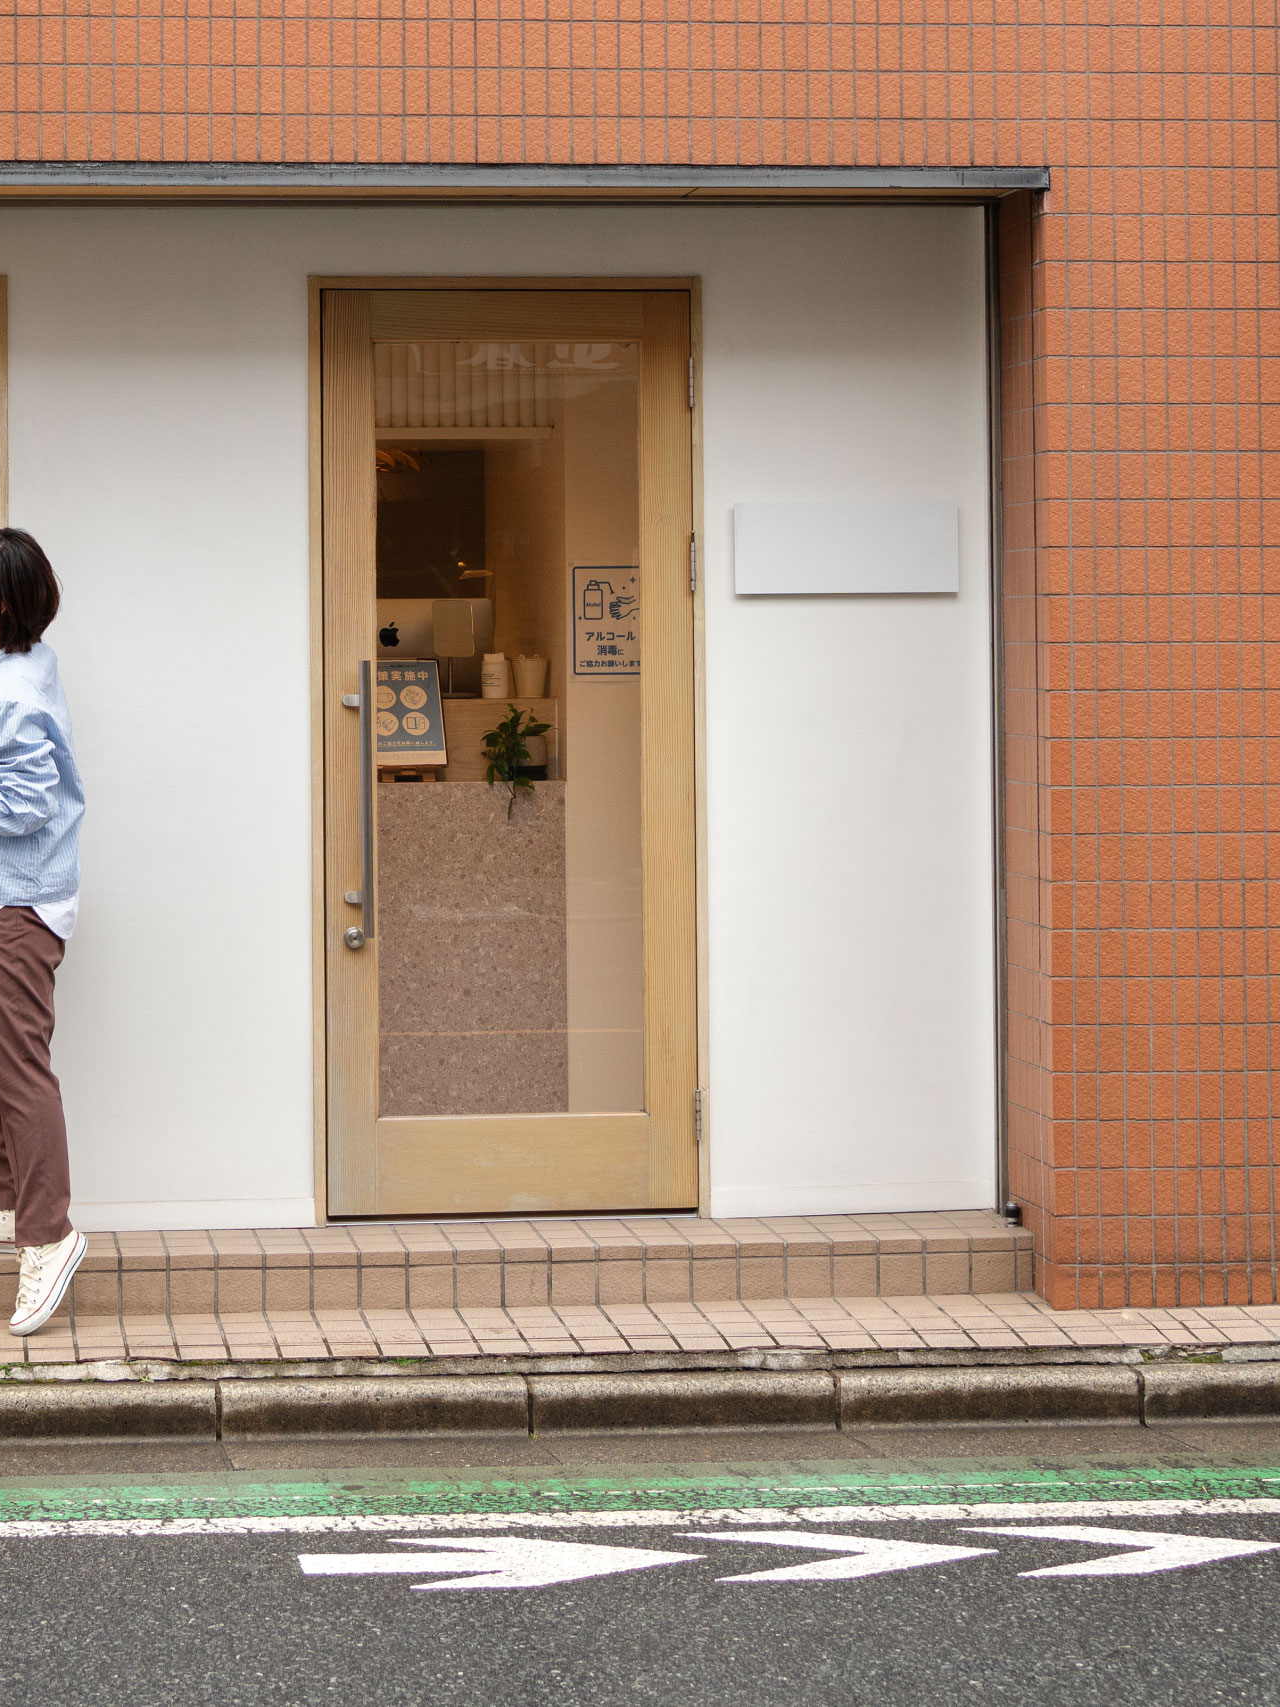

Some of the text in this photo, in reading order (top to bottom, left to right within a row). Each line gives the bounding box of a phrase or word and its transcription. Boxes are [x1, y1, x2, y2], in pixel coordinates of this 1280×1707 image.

[585, 631, 636, 641] アルコール
[597, 645, 624, 656] 消毒に
